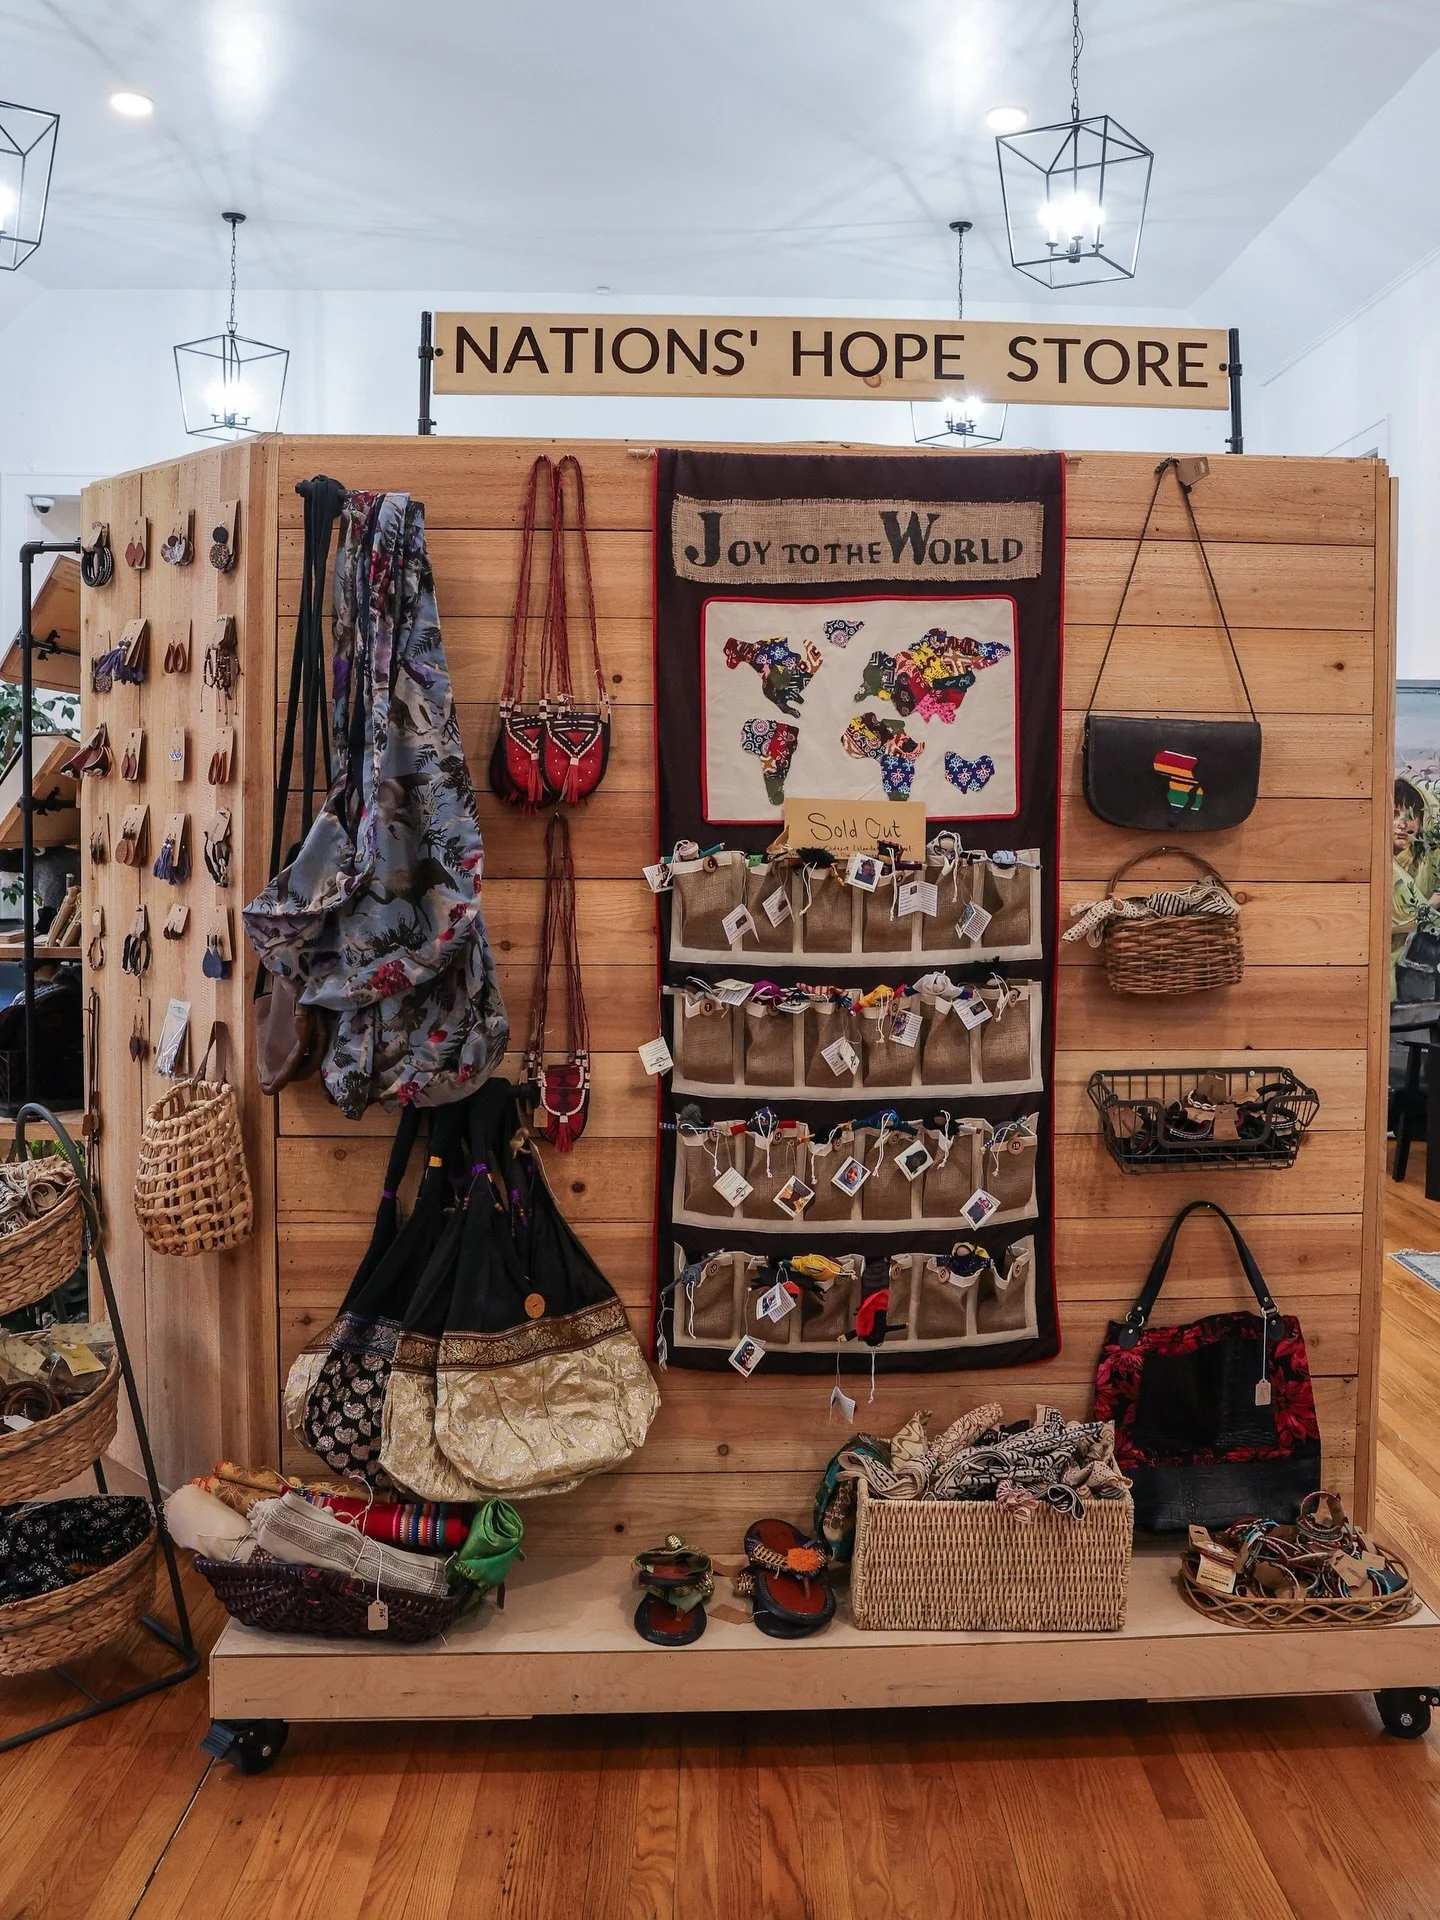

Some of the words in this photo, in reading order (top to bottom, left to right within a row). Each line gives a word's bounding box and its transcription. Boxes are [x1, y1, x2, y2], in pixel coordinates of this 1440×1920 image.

[455, 326, 758, 375] NATIONS'
[792, 330, 965, 380] HOPE
[1006, 336, 1209, 388] STORE
[807, 812, 858, 841] Sold
[864, 817, 902, 840] Out
